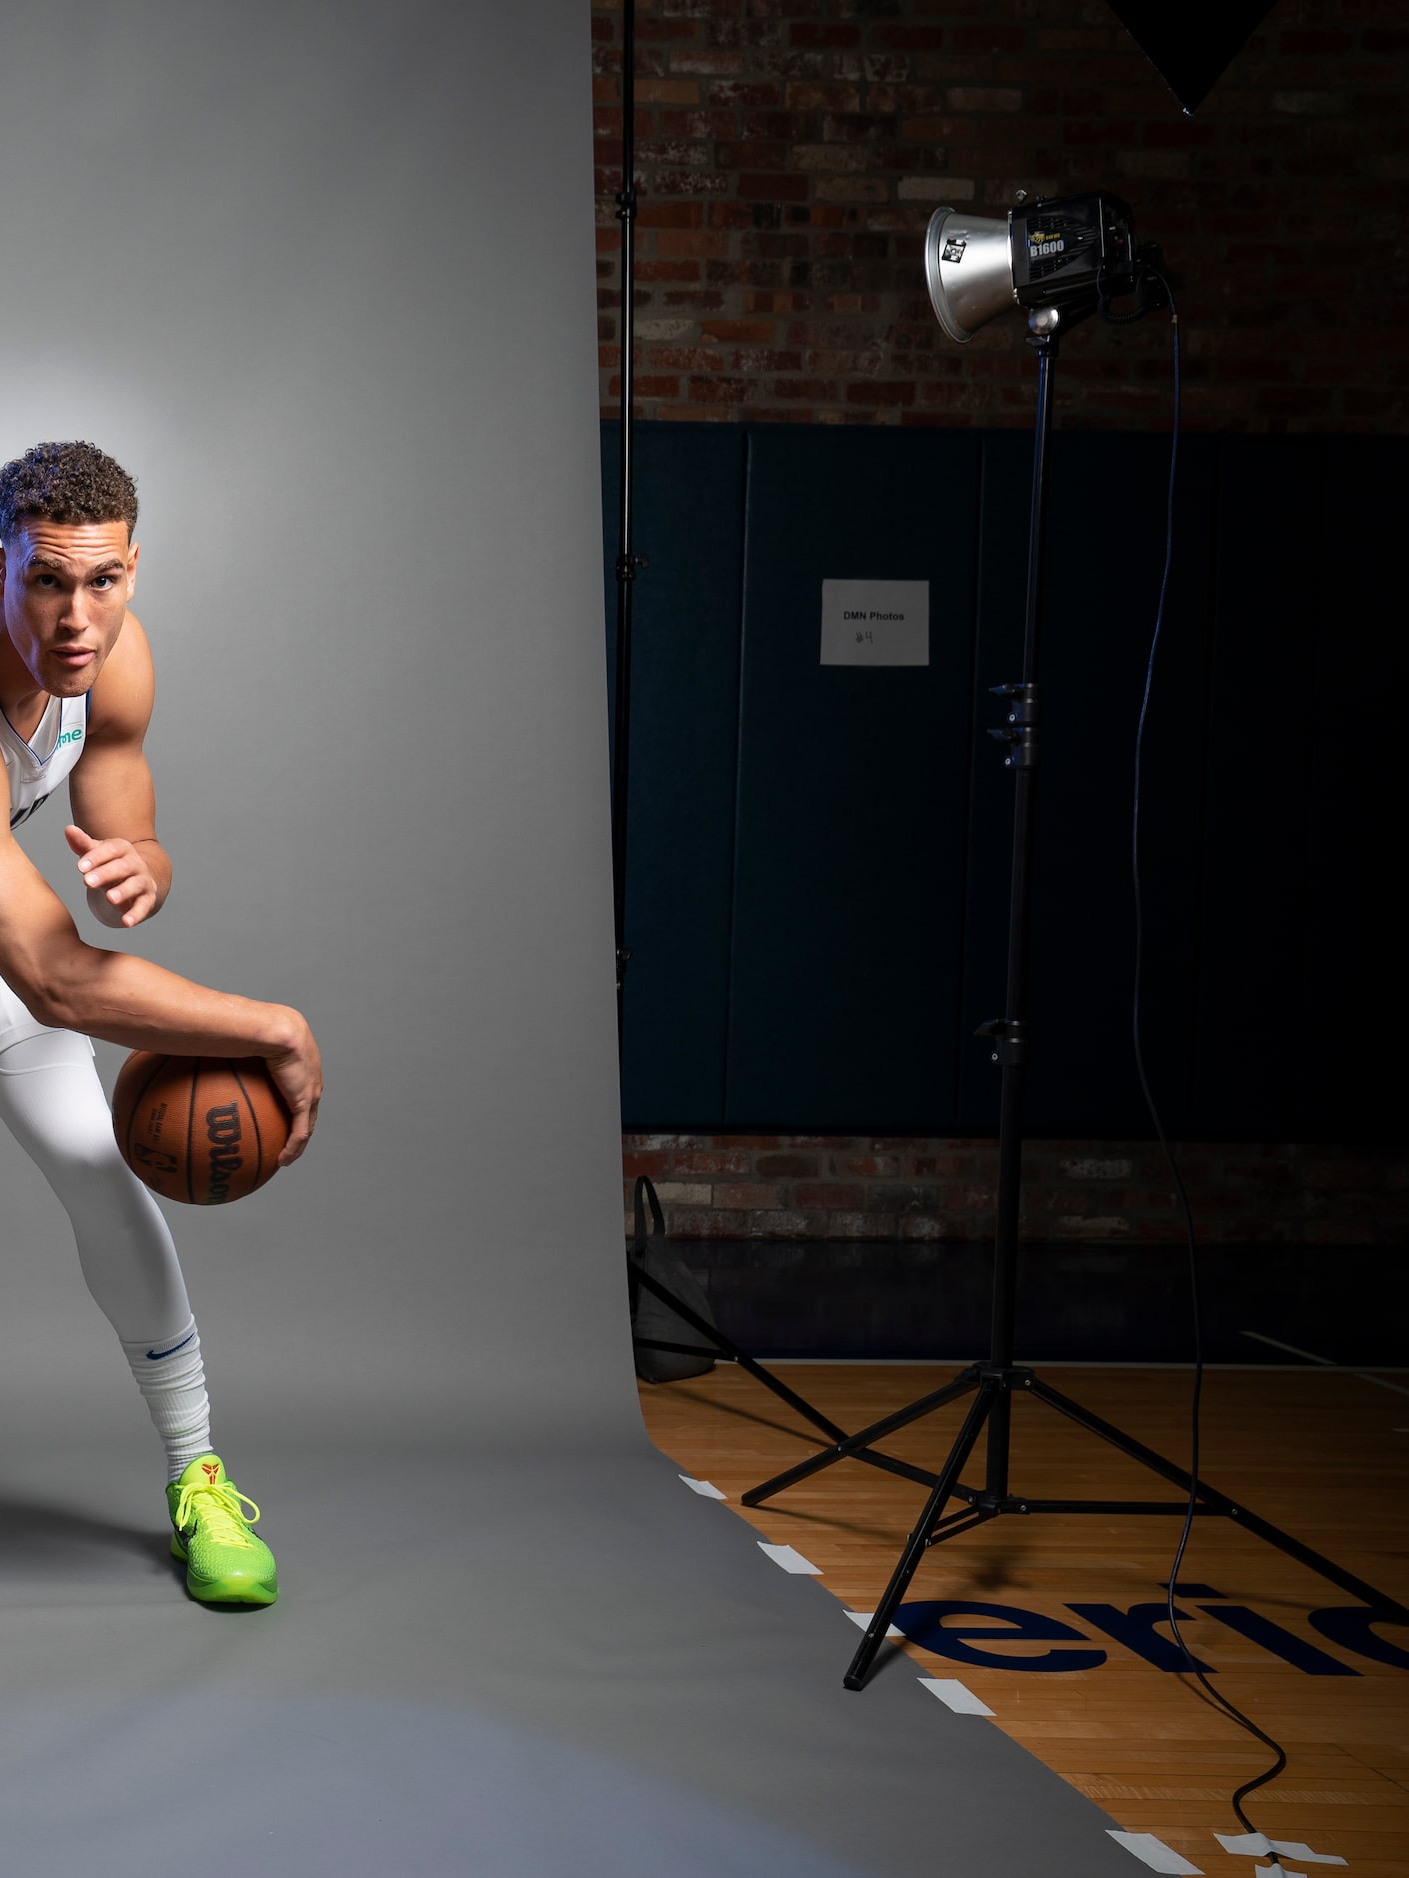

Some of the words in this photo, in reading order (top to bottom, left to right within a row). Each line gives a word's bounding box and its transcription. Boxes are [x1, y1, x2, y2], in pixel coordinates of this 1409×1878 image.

[1030, 239, 1065, 258] B1600
[843, 610, 867, 621] DMN
[869, 611, 905, 621] Photos
[855, 630, 873, 644] #4
